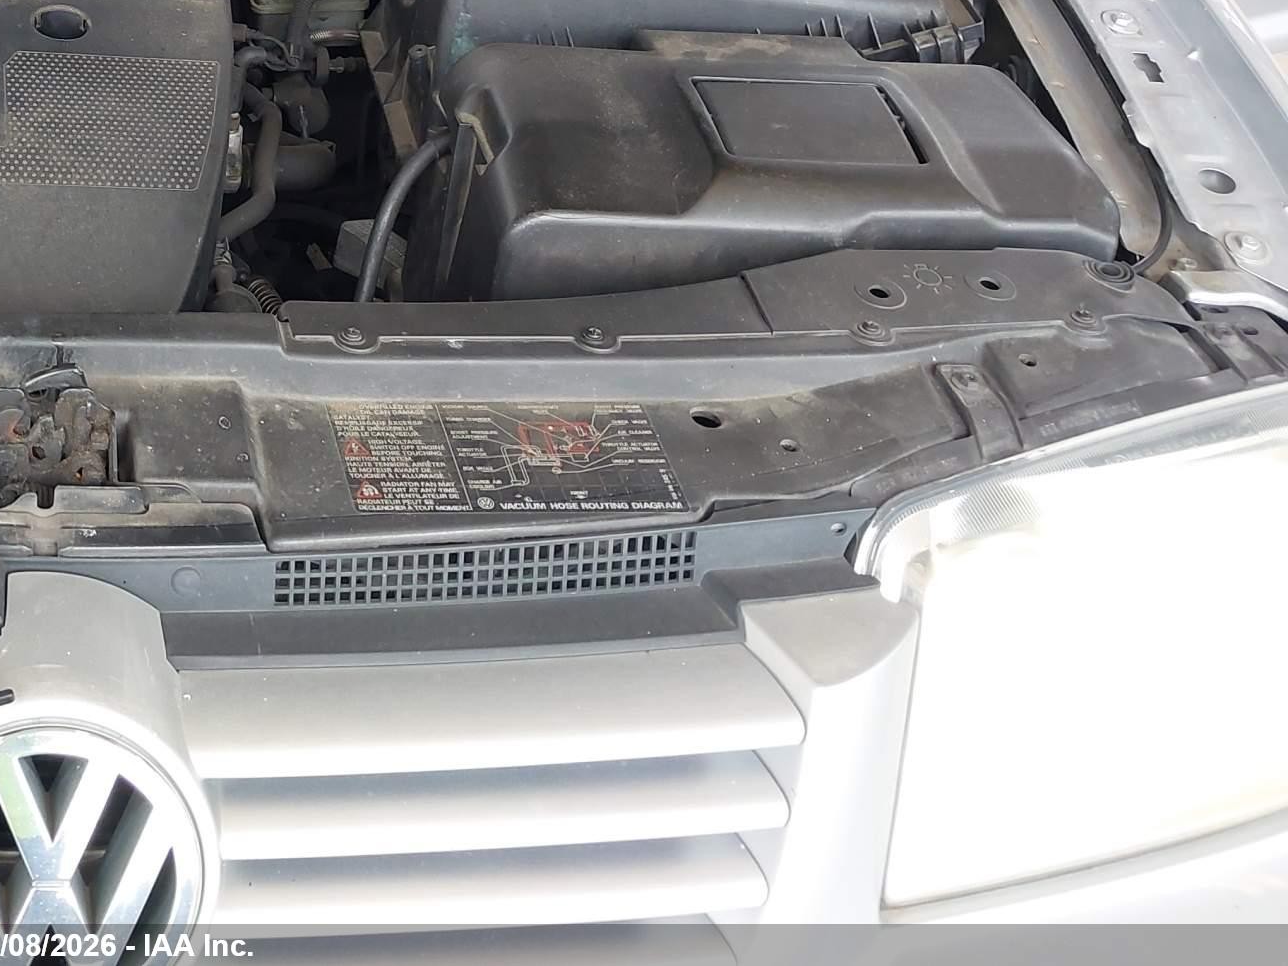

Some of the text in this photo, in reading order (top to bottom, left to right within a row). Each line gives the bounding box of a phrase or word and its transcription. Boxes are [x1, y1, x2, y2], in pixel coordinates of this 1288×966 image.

[499, 501, 684, 511] VACUUM HOSE ROUTING DIAGRAM
